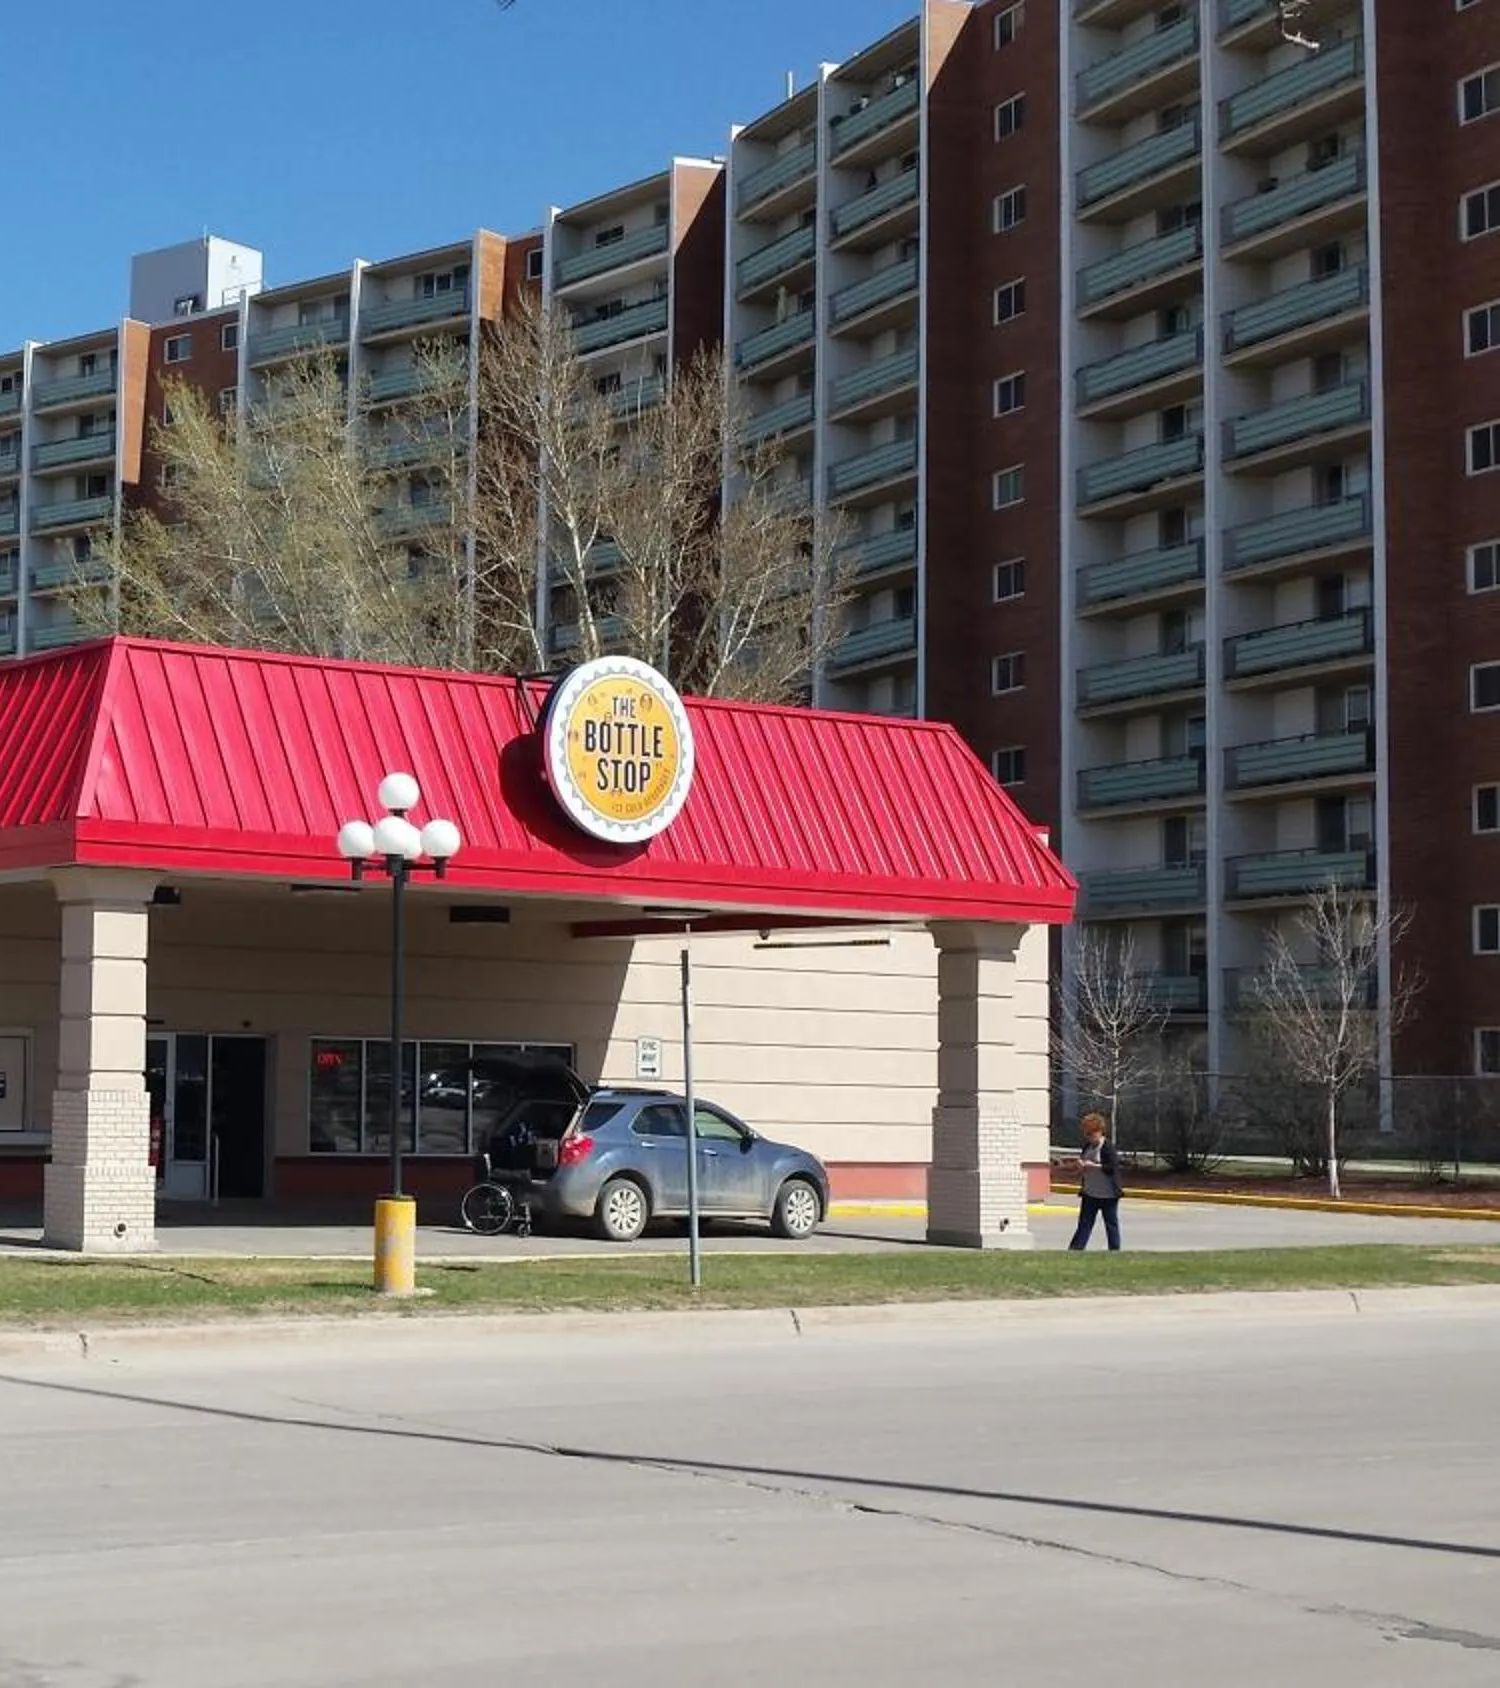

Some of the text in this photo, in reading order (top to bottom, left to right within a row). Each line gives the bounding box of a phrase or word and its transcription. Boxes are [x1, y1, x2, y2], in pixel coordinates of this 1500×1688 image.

[612, 696, 637, 719] THE
[584, 719, 664, 759] BOTTLE
[597, 757, 651, 793] STOP
